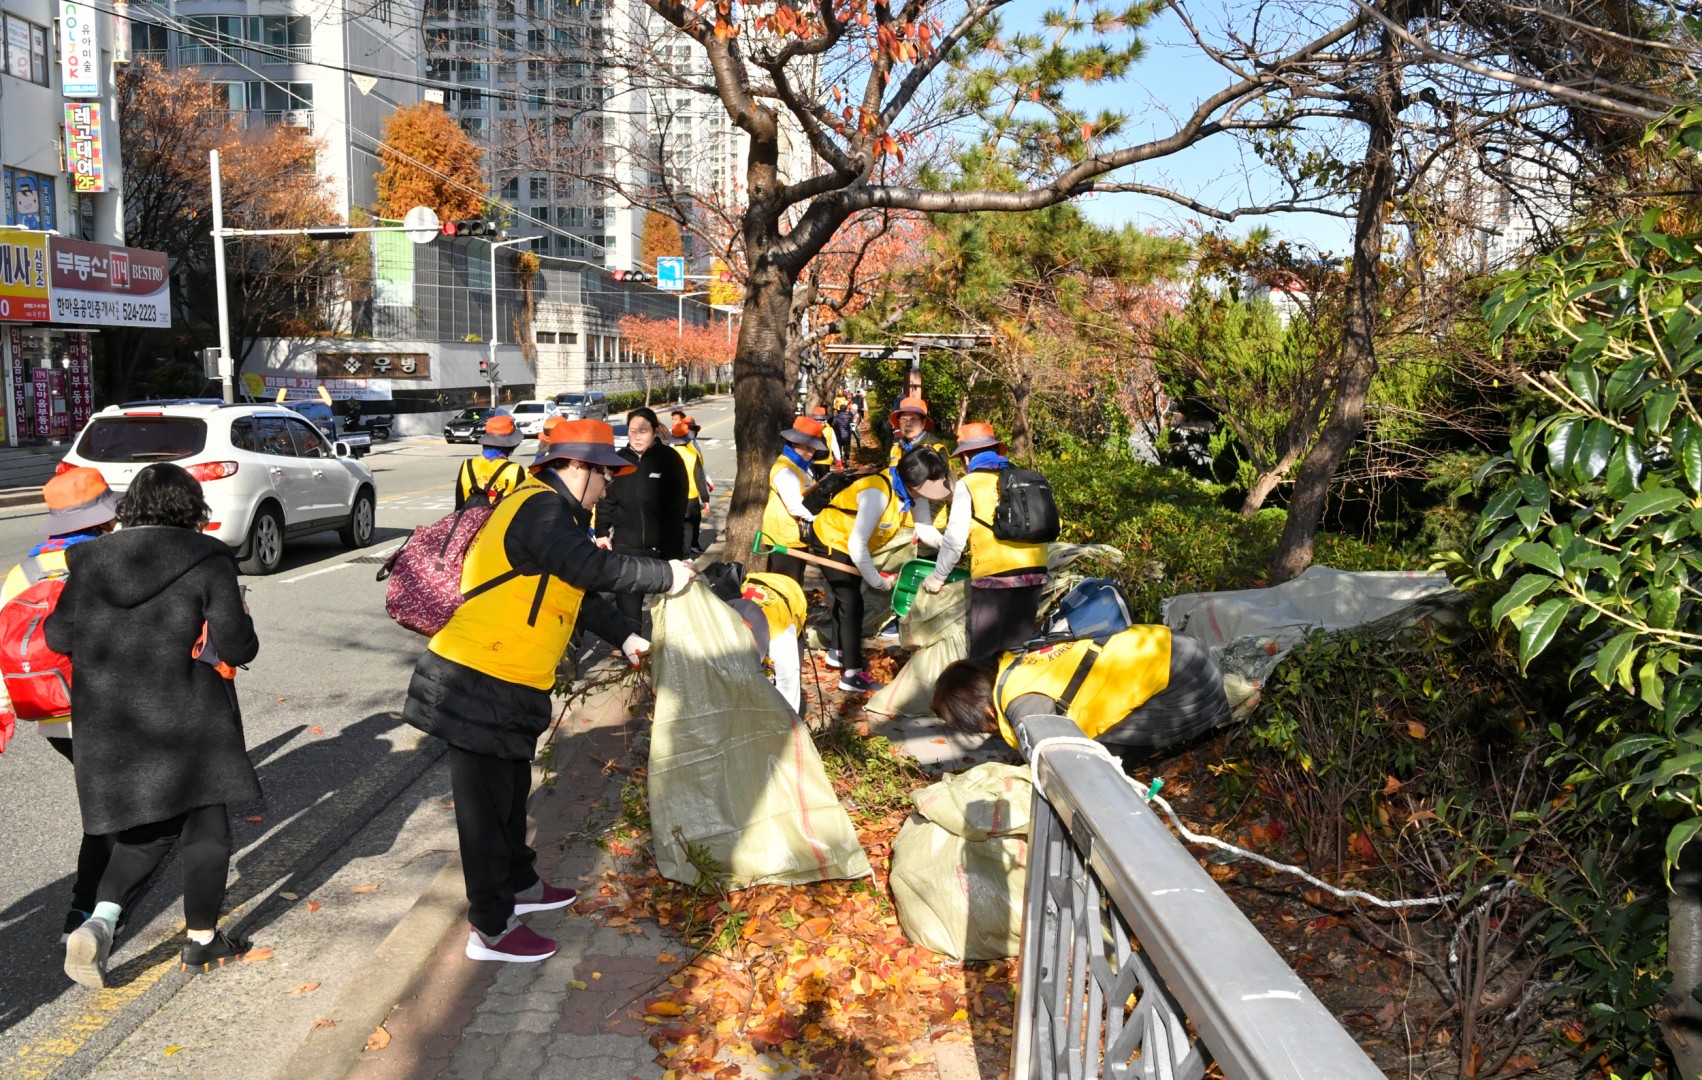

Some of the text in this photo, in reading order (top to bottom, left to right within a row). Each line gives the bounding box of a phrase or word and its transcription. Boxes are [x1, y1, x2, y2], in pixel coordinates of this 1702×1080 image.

[73, 106, 93, 177] 레고대여
[78, 176, 95, 190] 2F
[34, 249, 45, 287] 사무소
[56, 250, 162, 281] 부동산 114 BESTRO
[57, 297, 116, 319] 한마음공인중개사
[373, 356, 416, 374] 우방
[36, 382, 50, 434] 한마음부동산
